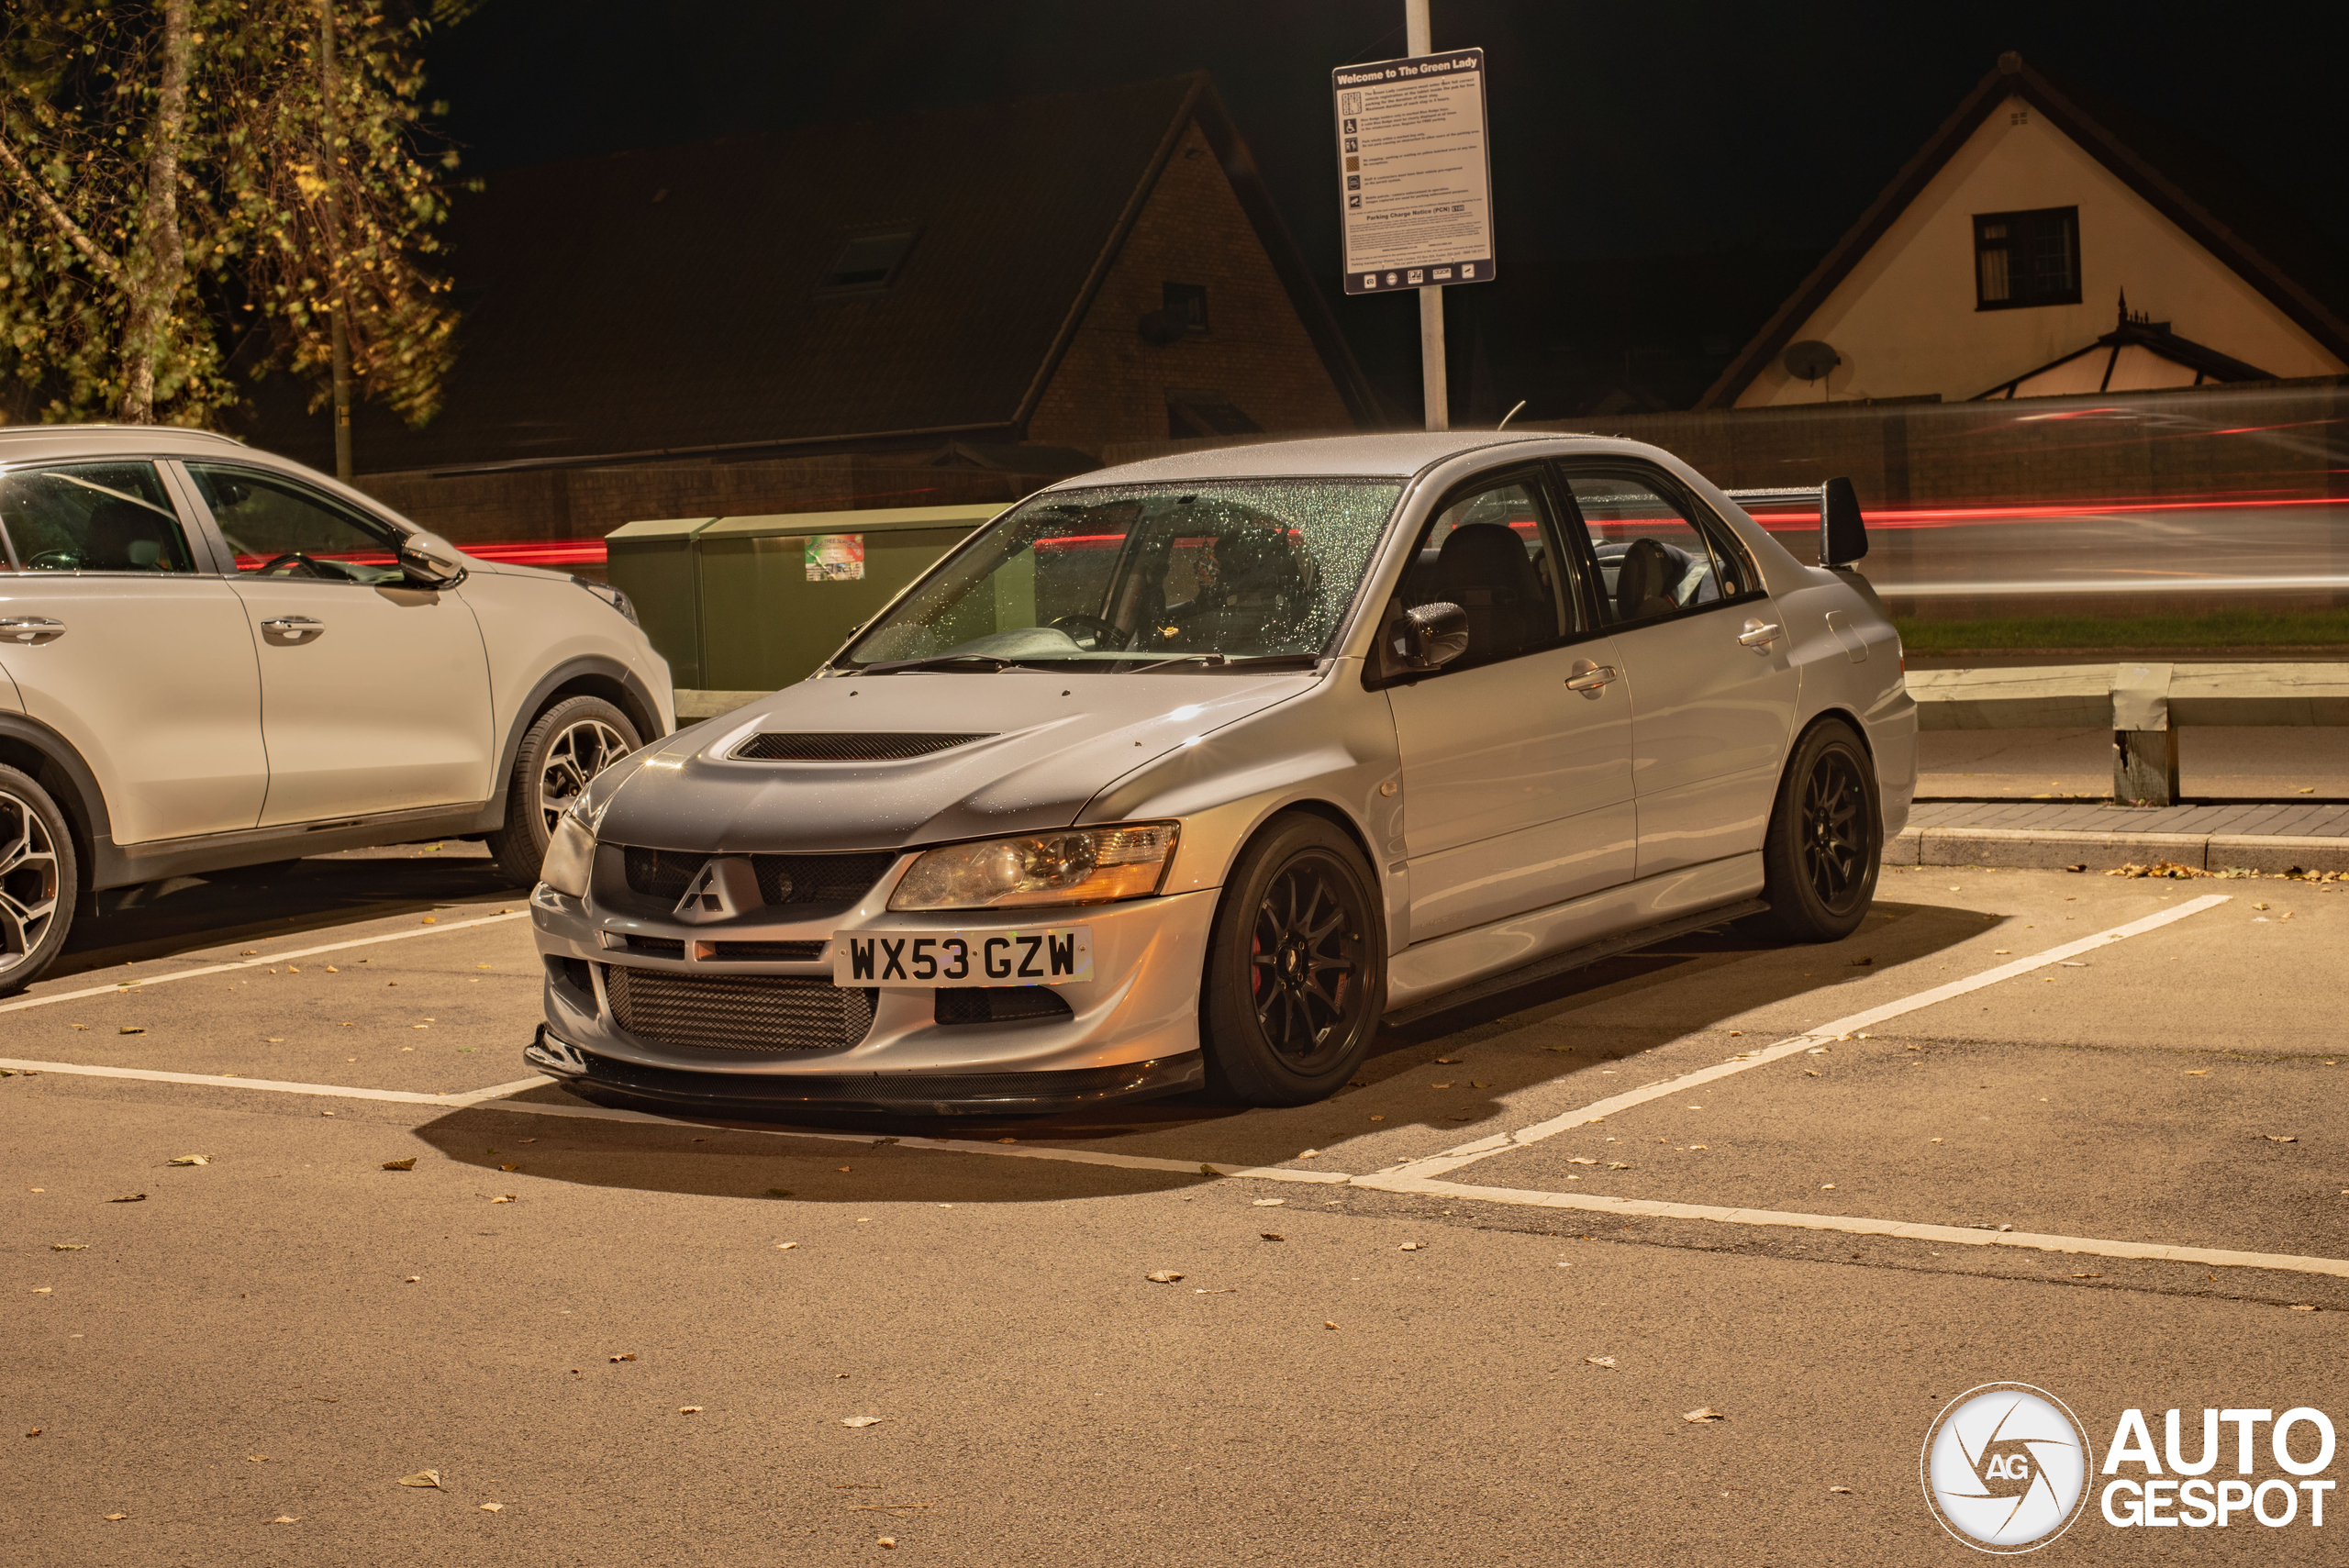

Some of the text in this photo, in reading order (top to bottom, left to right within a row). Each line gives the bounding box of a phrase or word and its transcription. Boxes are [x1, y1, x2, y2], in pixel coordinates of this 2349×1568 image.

[1337, 57, 1477, 85] Welcome to The Green Lady
[851, 933, 1074, 980] WX53 GZW
